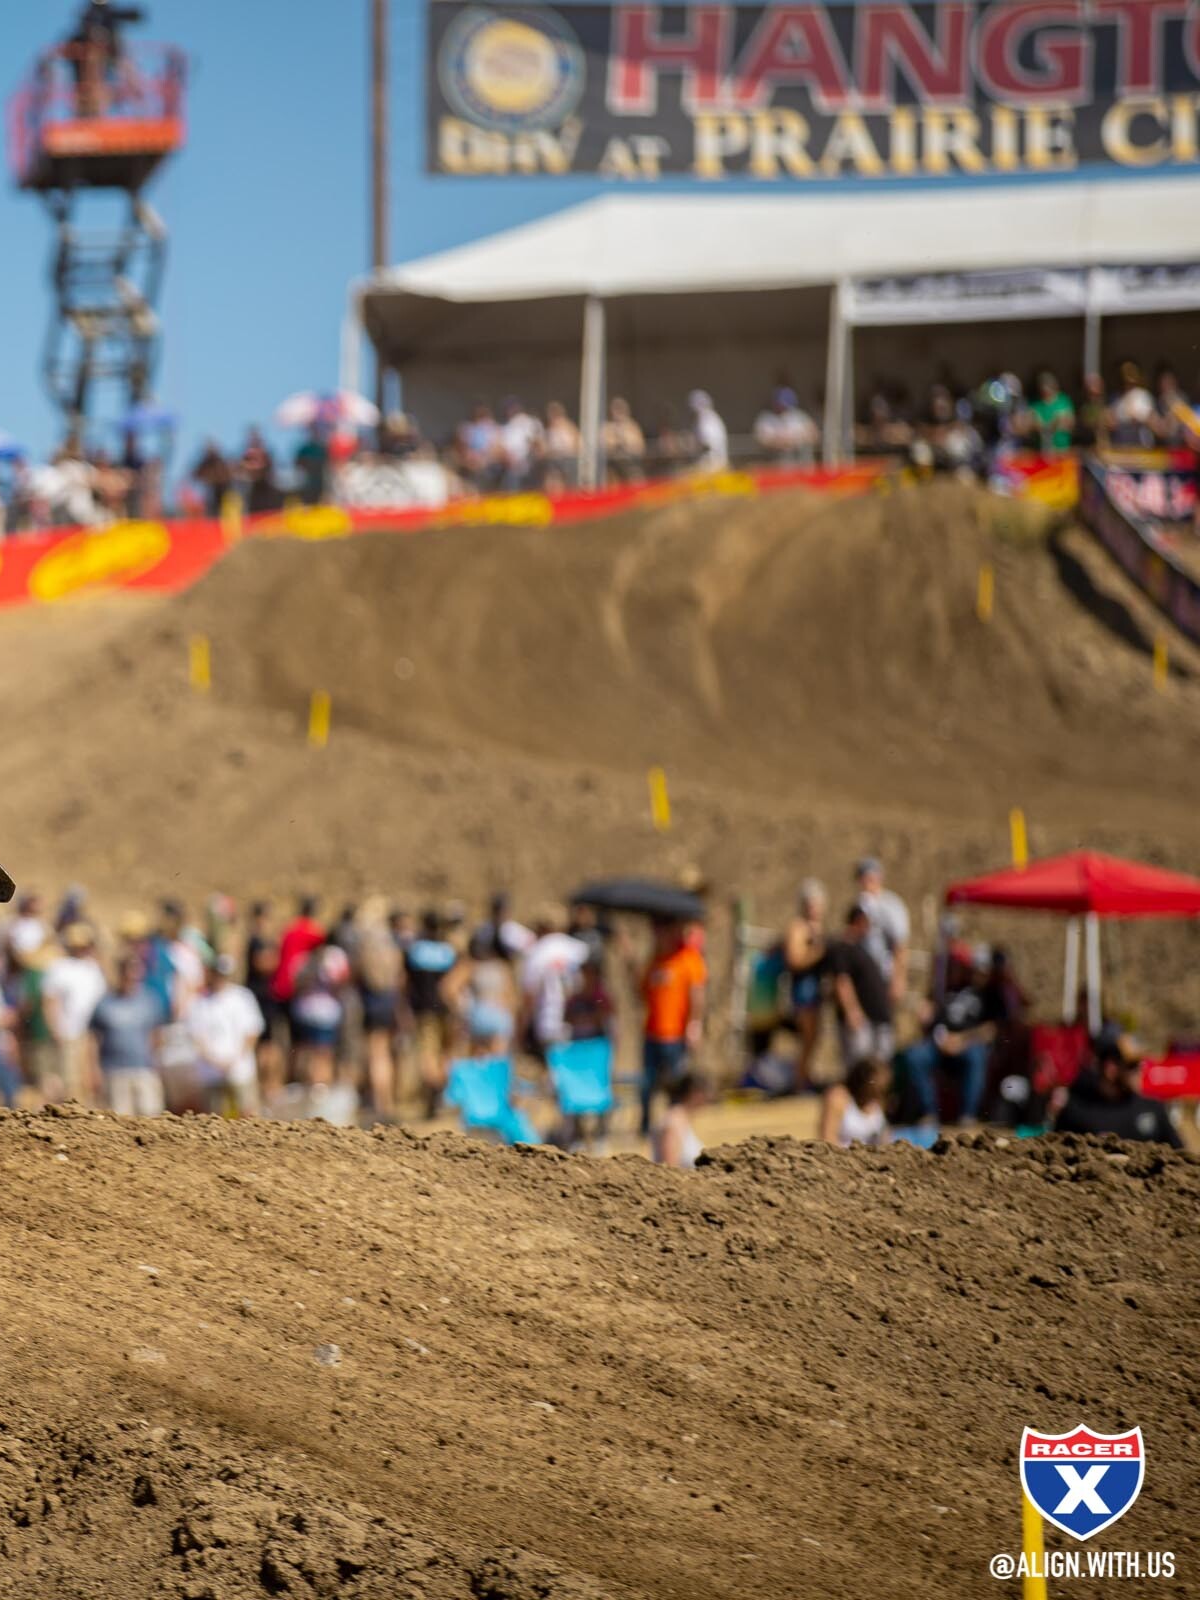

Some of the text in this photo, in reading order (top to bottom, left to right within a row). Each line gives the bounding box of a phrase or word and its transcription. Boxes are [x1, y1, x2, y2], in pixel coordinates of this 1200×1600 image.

[605, 0, 1200, 118] HANGT
[599, 134, 672, 180] AT
[693, 100, 1080, 181] PRAIRIE
[1102, 92, 1200, 168] CI
